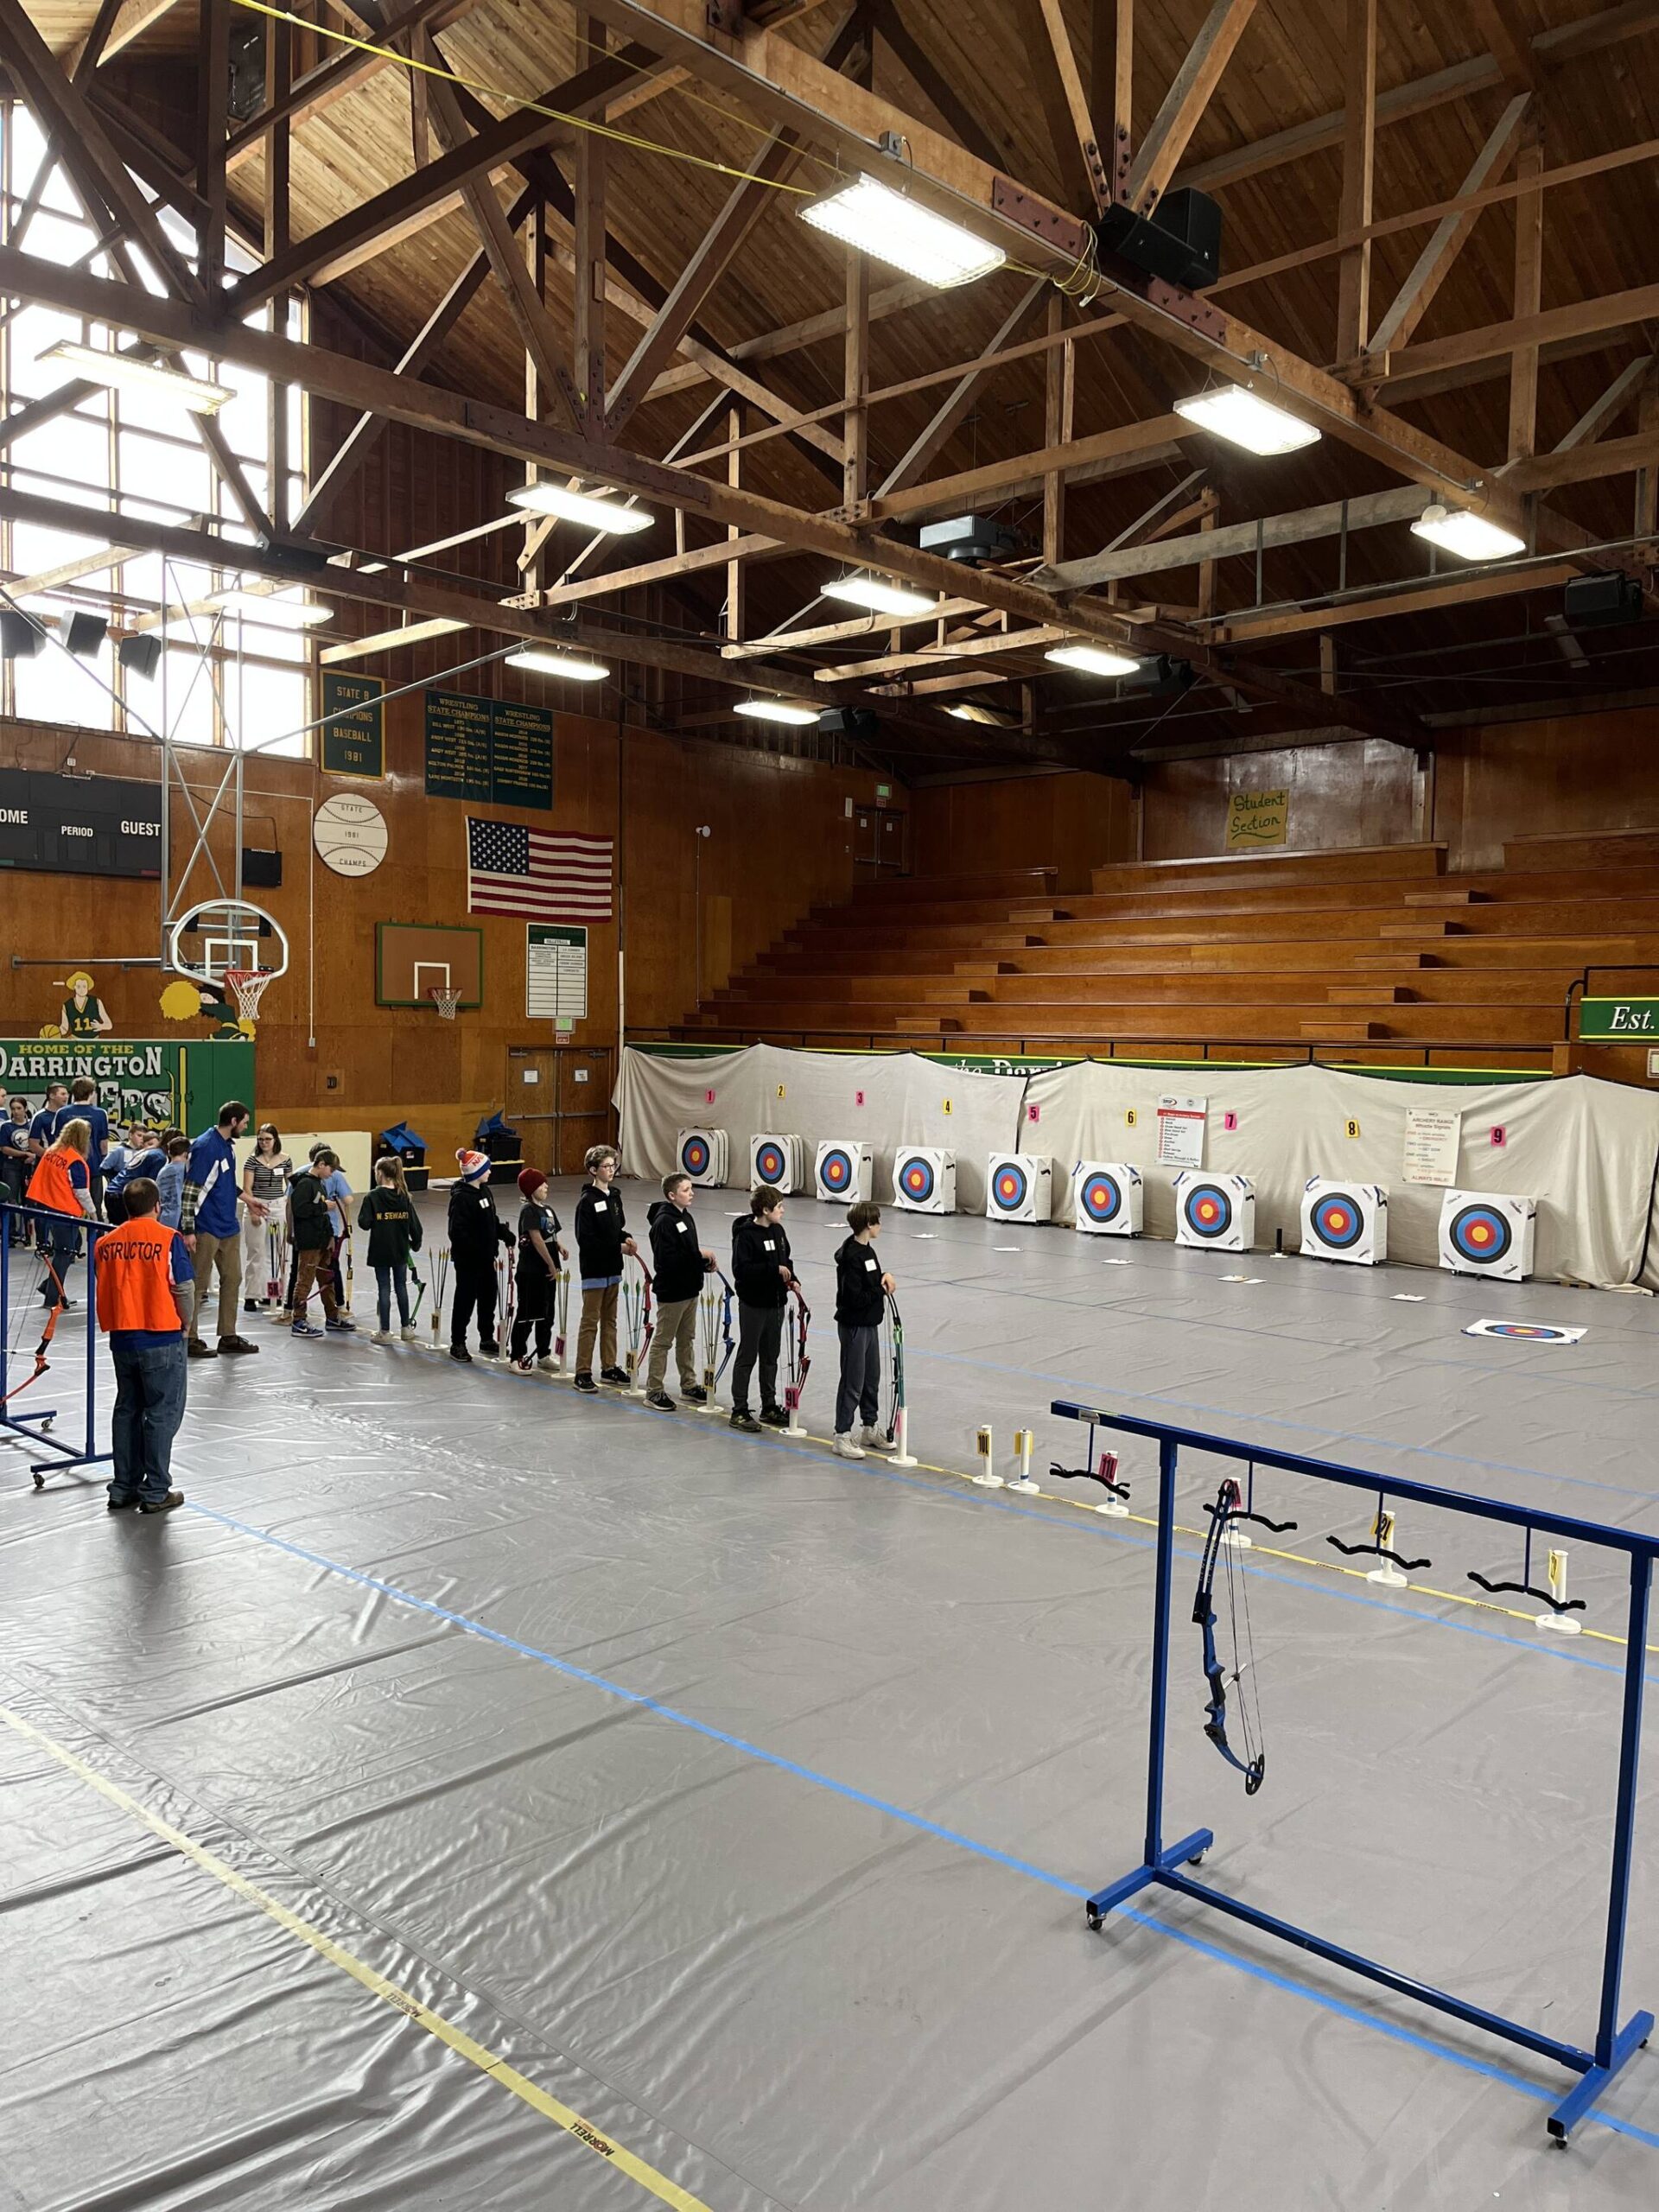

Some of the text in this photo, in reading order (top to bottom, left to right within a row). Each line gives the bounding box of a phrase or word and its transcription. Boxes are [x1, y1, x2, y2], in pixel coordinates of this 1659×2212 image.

[336, 686, 359, 699] STATE
[428, 705, 450, 715] STATE
[439, 698, 479, 710] WRESTLING
[494, 716, 515, 726] STATE
[505, 709, 540, 721] WRESTLING
[333, 728, 372, 742] BASEBALL
[345, 750, 362, 762] 1981
[1234, 791, 1286, 811] Student
[340, 804, 362, 813] STATE
[121, 820, 161, 836] GUEST
[1230, 815, 1281, 833] Section
[61, 825, 93, 837] PERIOD
[339, 858, 366, 867] CHAMPS
[1609, 1006, 1655, 1030] Est.
[19, 1045, 134, 1054] HOME OF THE
[708, 1090, 712, 1102] 1
[779, 1085, 784, 1096] 2
[858, 1093, 863, 1103] 3
[945, 1101, 950, 1112] 4
[1030, 1106, 1037, 1119] 5
[1128, 1111, 1134, 1123] 6
[1228, 1114, 1234, 1127] 7
[1348, 1122, 1356, 1135] 8
[1493, 1128, 1502, 1143] 9
[785, 1393, 798, 1408] 9L
[570, 2122, 615, 2157] MORRELL
